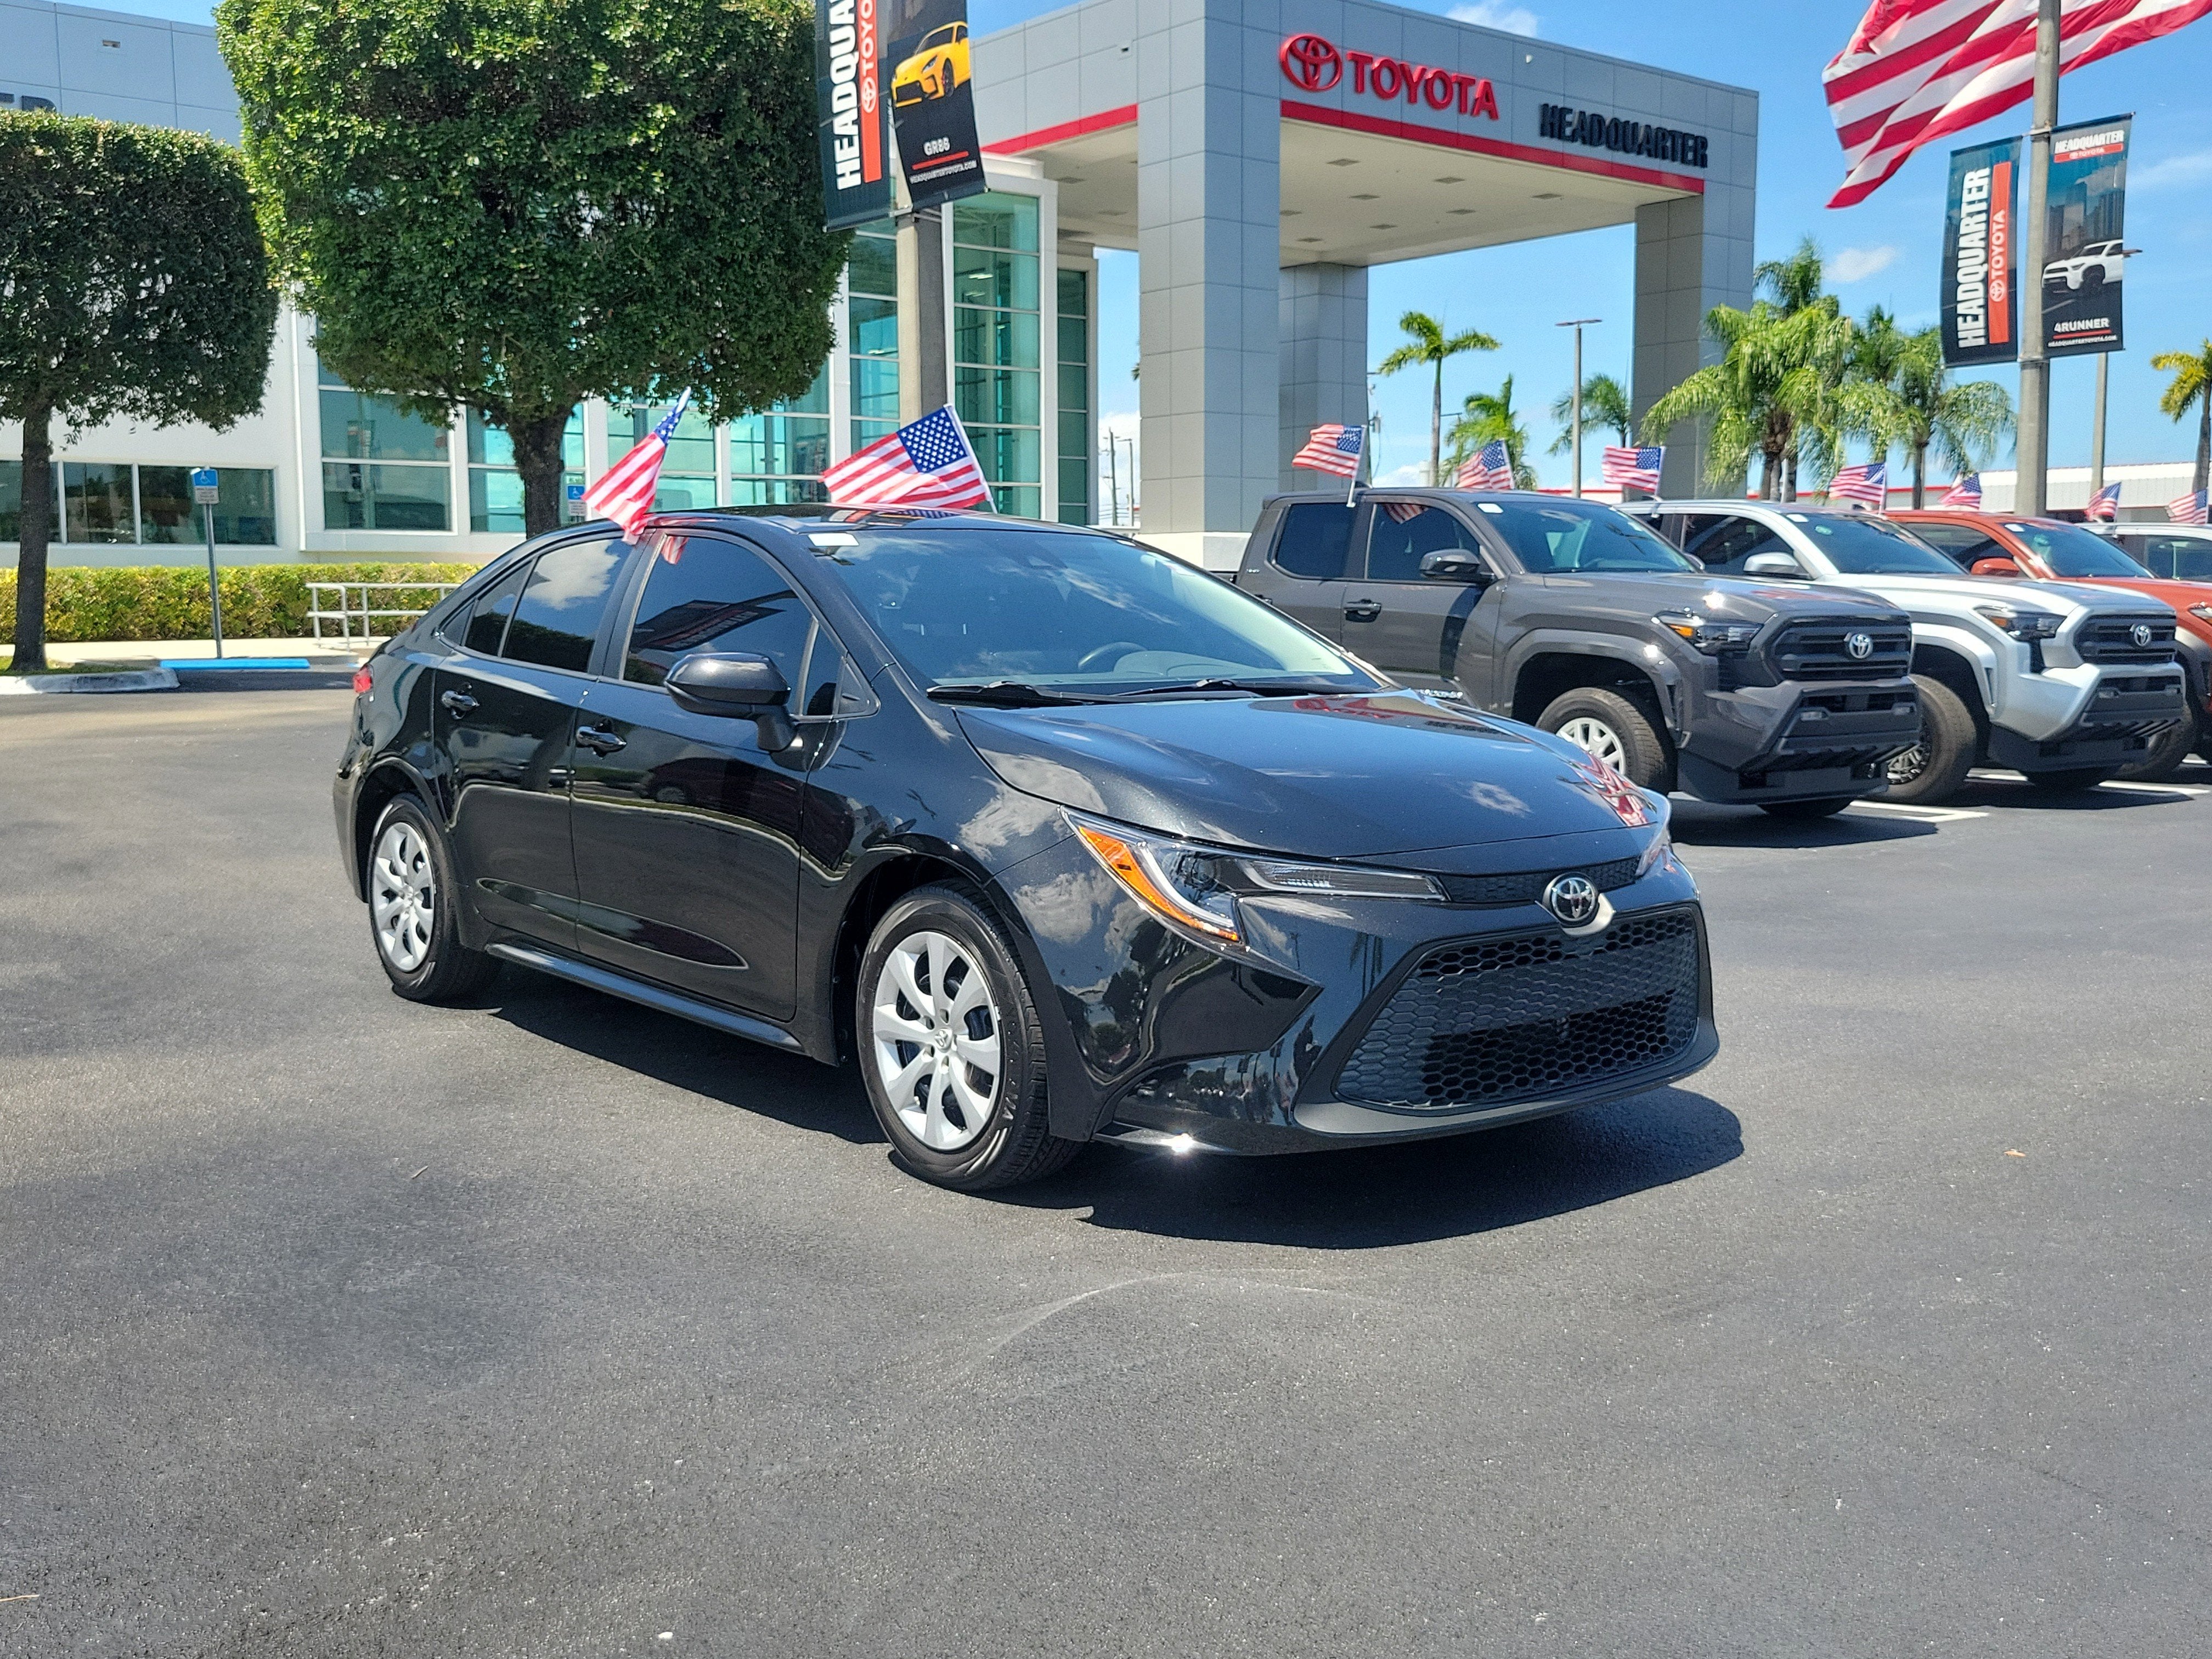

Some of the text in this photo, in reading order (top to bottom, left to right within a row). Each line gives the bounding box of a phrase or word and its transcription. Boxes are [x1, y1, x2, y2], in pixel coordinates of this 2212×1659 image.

[828, 0, 861, 190] HEADQUA
[1346, 50, 1708, 168] TOYOTA HEADQUARTER
[2055, 130, 2124, 154] HEADQUARTER
[2078, 147, 2105, 157] TOYOTA
[1957, 167, 1990, 348] HEADQUARTER
[1991, 210, 2006, 280] TOYOTA
[2054, 318, 2110, 332] 4RUNNER
